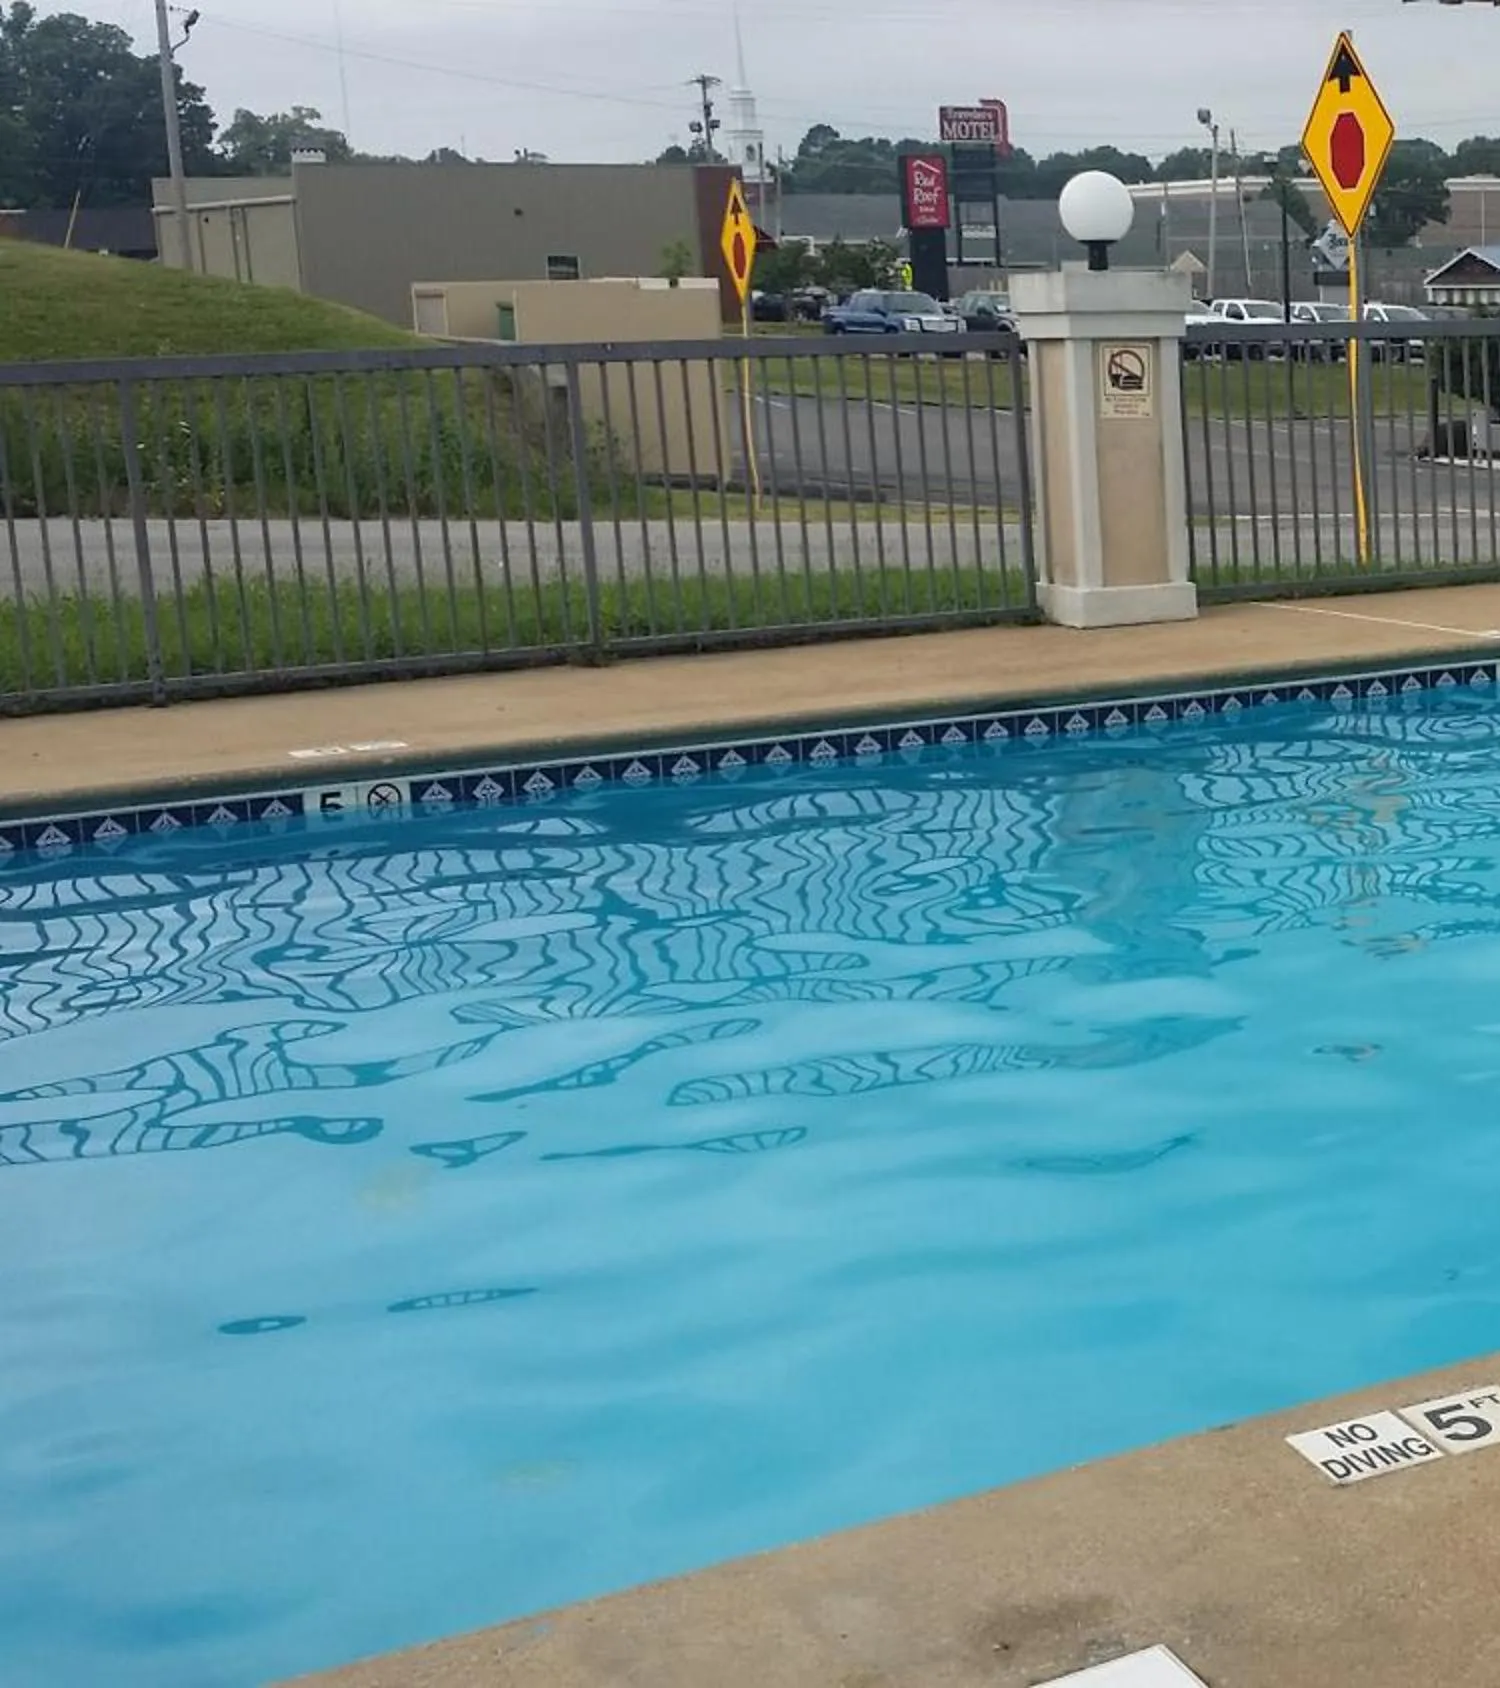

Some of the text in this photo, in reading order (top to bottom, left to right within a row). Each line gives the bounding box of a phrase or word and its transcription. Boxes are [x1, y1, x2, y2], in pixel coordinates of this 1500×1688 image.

[943, 121, 995, 139] MOTEL
[914, 171, 936, 186] Red
[913, 187, 941, 204] Roof
[1423, 1403, 1493, 1441] 5
[1324, 1423, 1378, 1449] NO
[1320, 1436, 1434, 1480] DIVING
